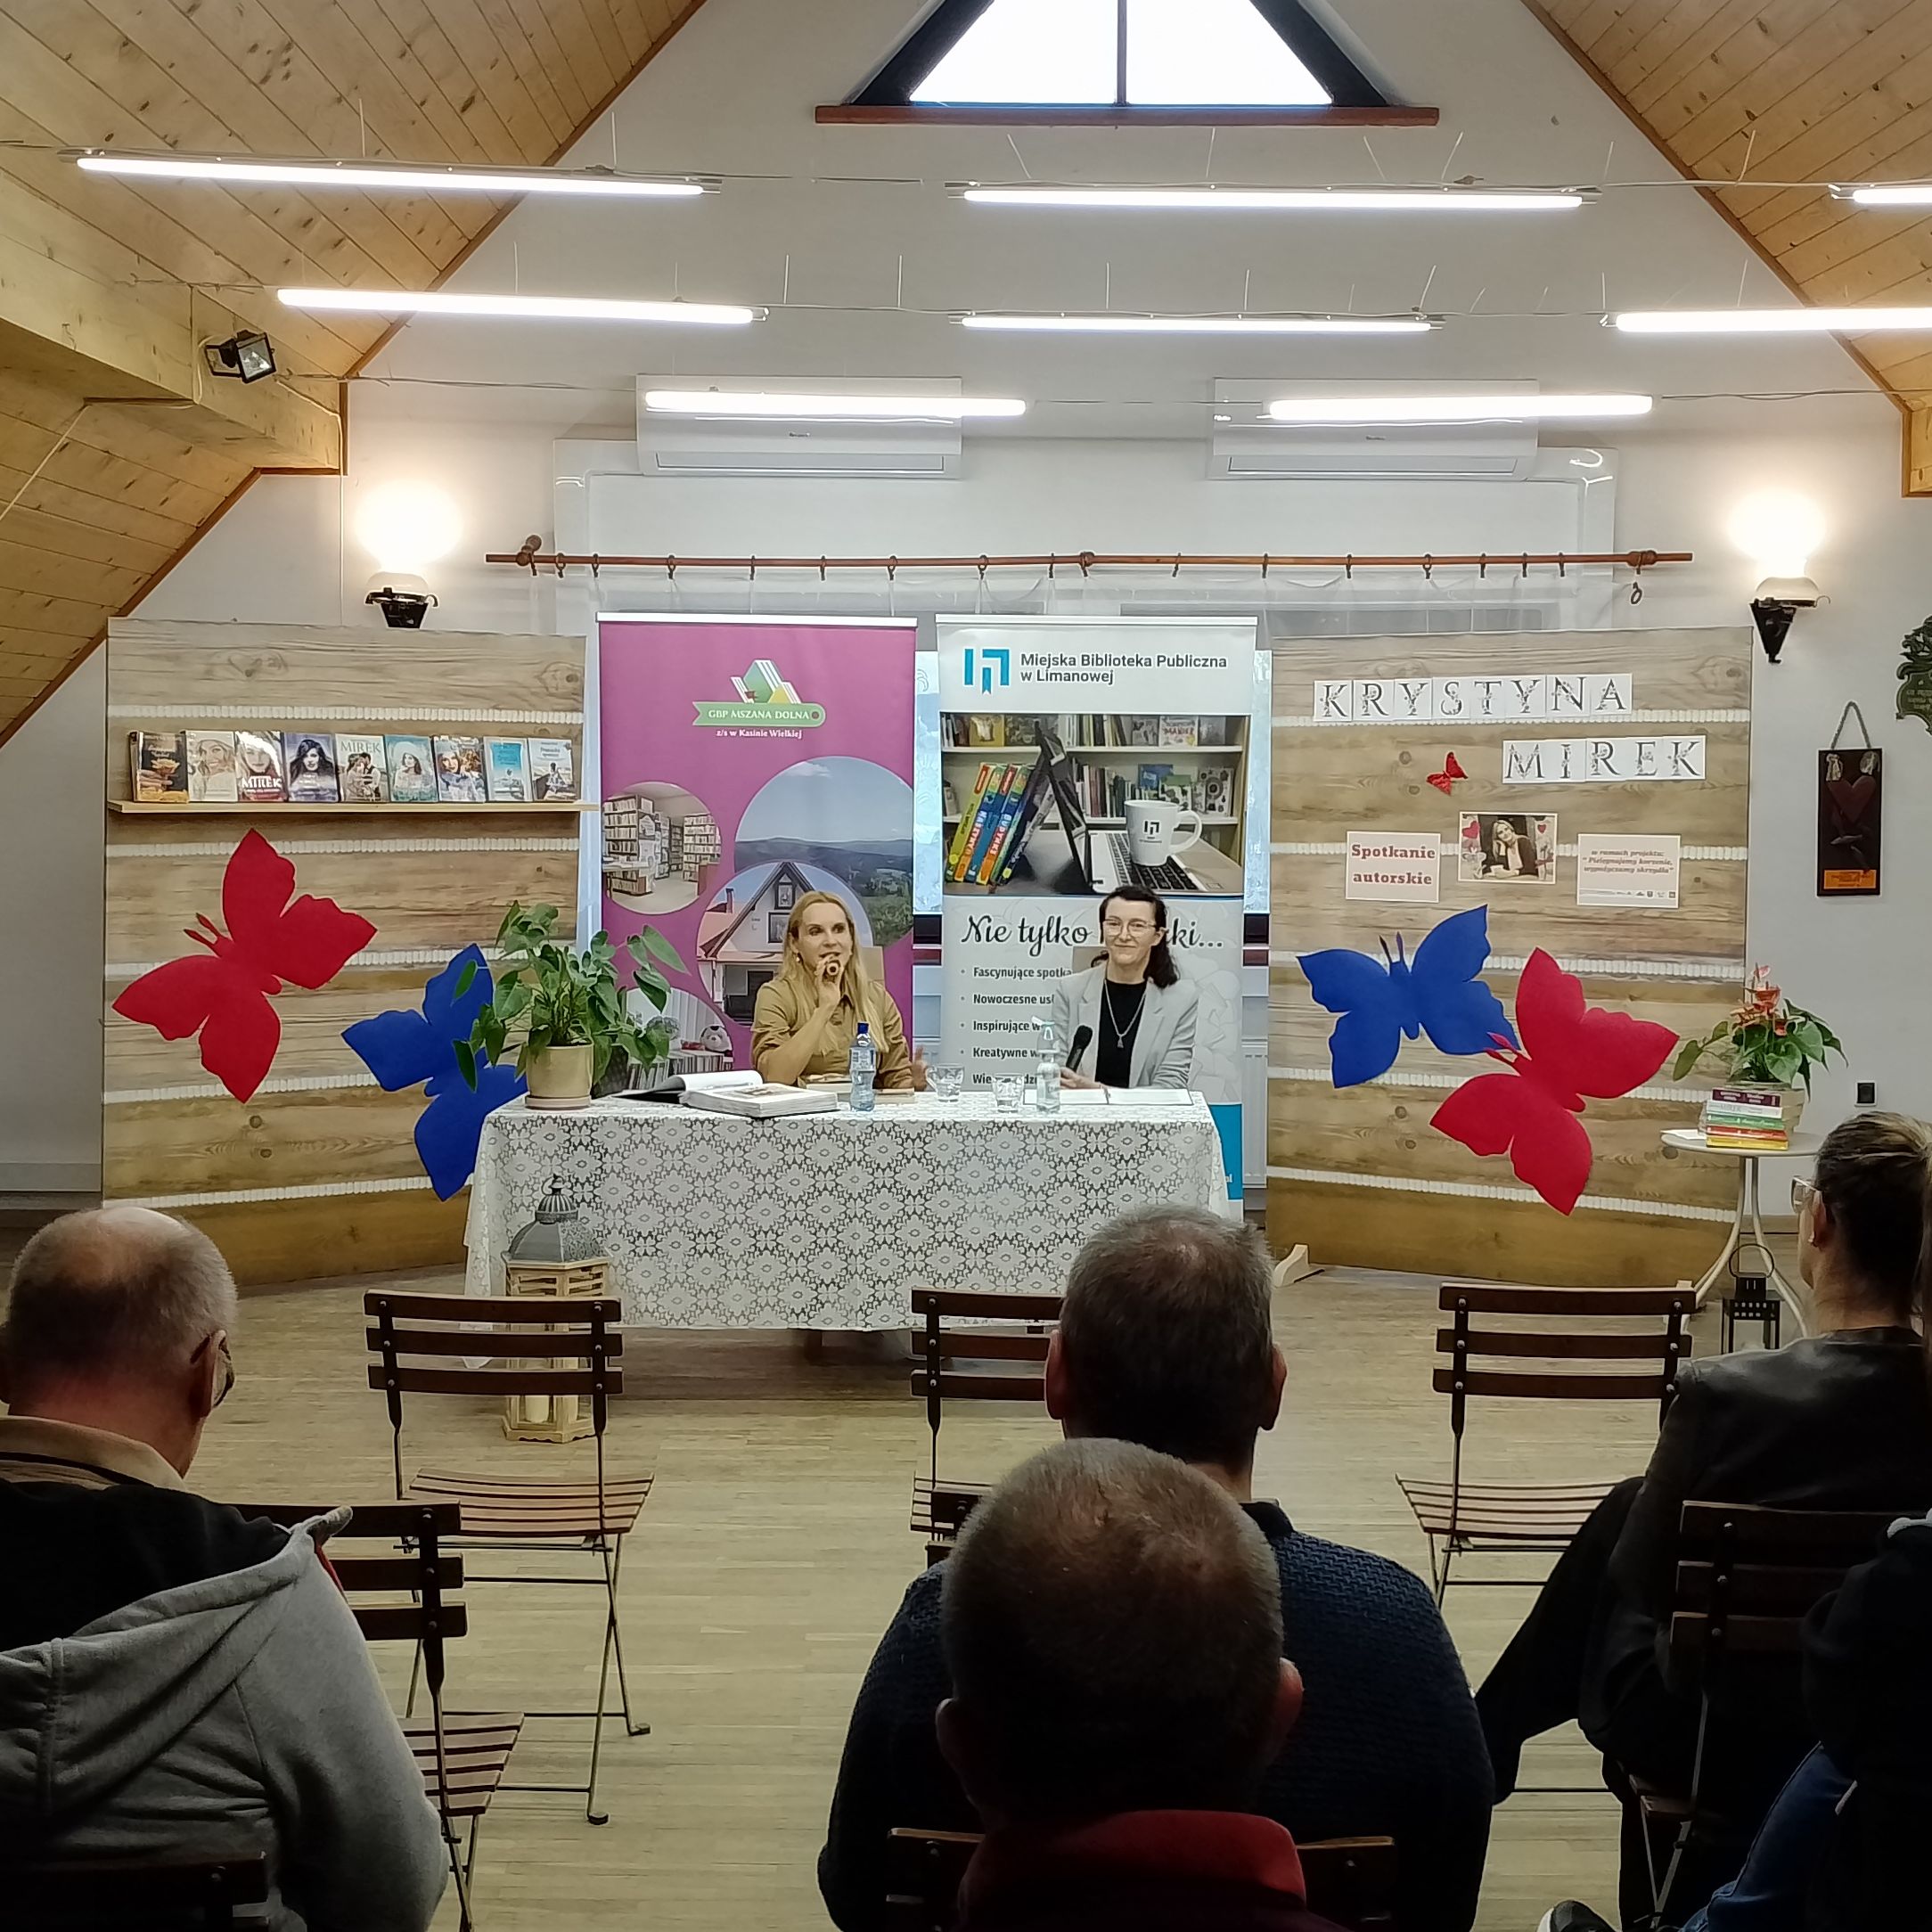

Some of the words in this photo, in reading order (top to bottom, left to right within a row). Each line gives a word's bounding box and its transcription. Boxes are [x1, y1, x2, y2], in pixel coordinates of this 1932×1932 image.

[1020, 653, 1077, 668] Miejska
[1080, 654, 1152, 667] Biblioteka
[1157, 654, 1227, 668] Publiczna
[1020, 672, 1033, 682] w
[1036, 670, 1114, 685] Limanowej
[1320, 677, 1627, 717] KRYSTYNA
[708, 709, 728, 719] GBP
[731, 710, 773, 719] MSZANA
[774, 711, 810, 720] DOLNA
[739, 729, 768, 738] Kasinie
[769, 730, 802, 740] Wielkiej
[341, 741, 382, 753] MIREK
[1504, 741, 1701, 779] MIREK
[1351, 844, 1436, 860] Spotkanie
[1353, 872, 1432, 885] autorskie
[961, 915, 1011, 943] Nie
[1017, 915, 1092, 957] tylko
[973, 966, 1035, 980] Fascynujące
[973, 994, 1037, 1005] Nowoczesne
[973, 1019, 1030, 1034] Inspirujące
[972, 1046, 1028, 1060] Kreatywne
